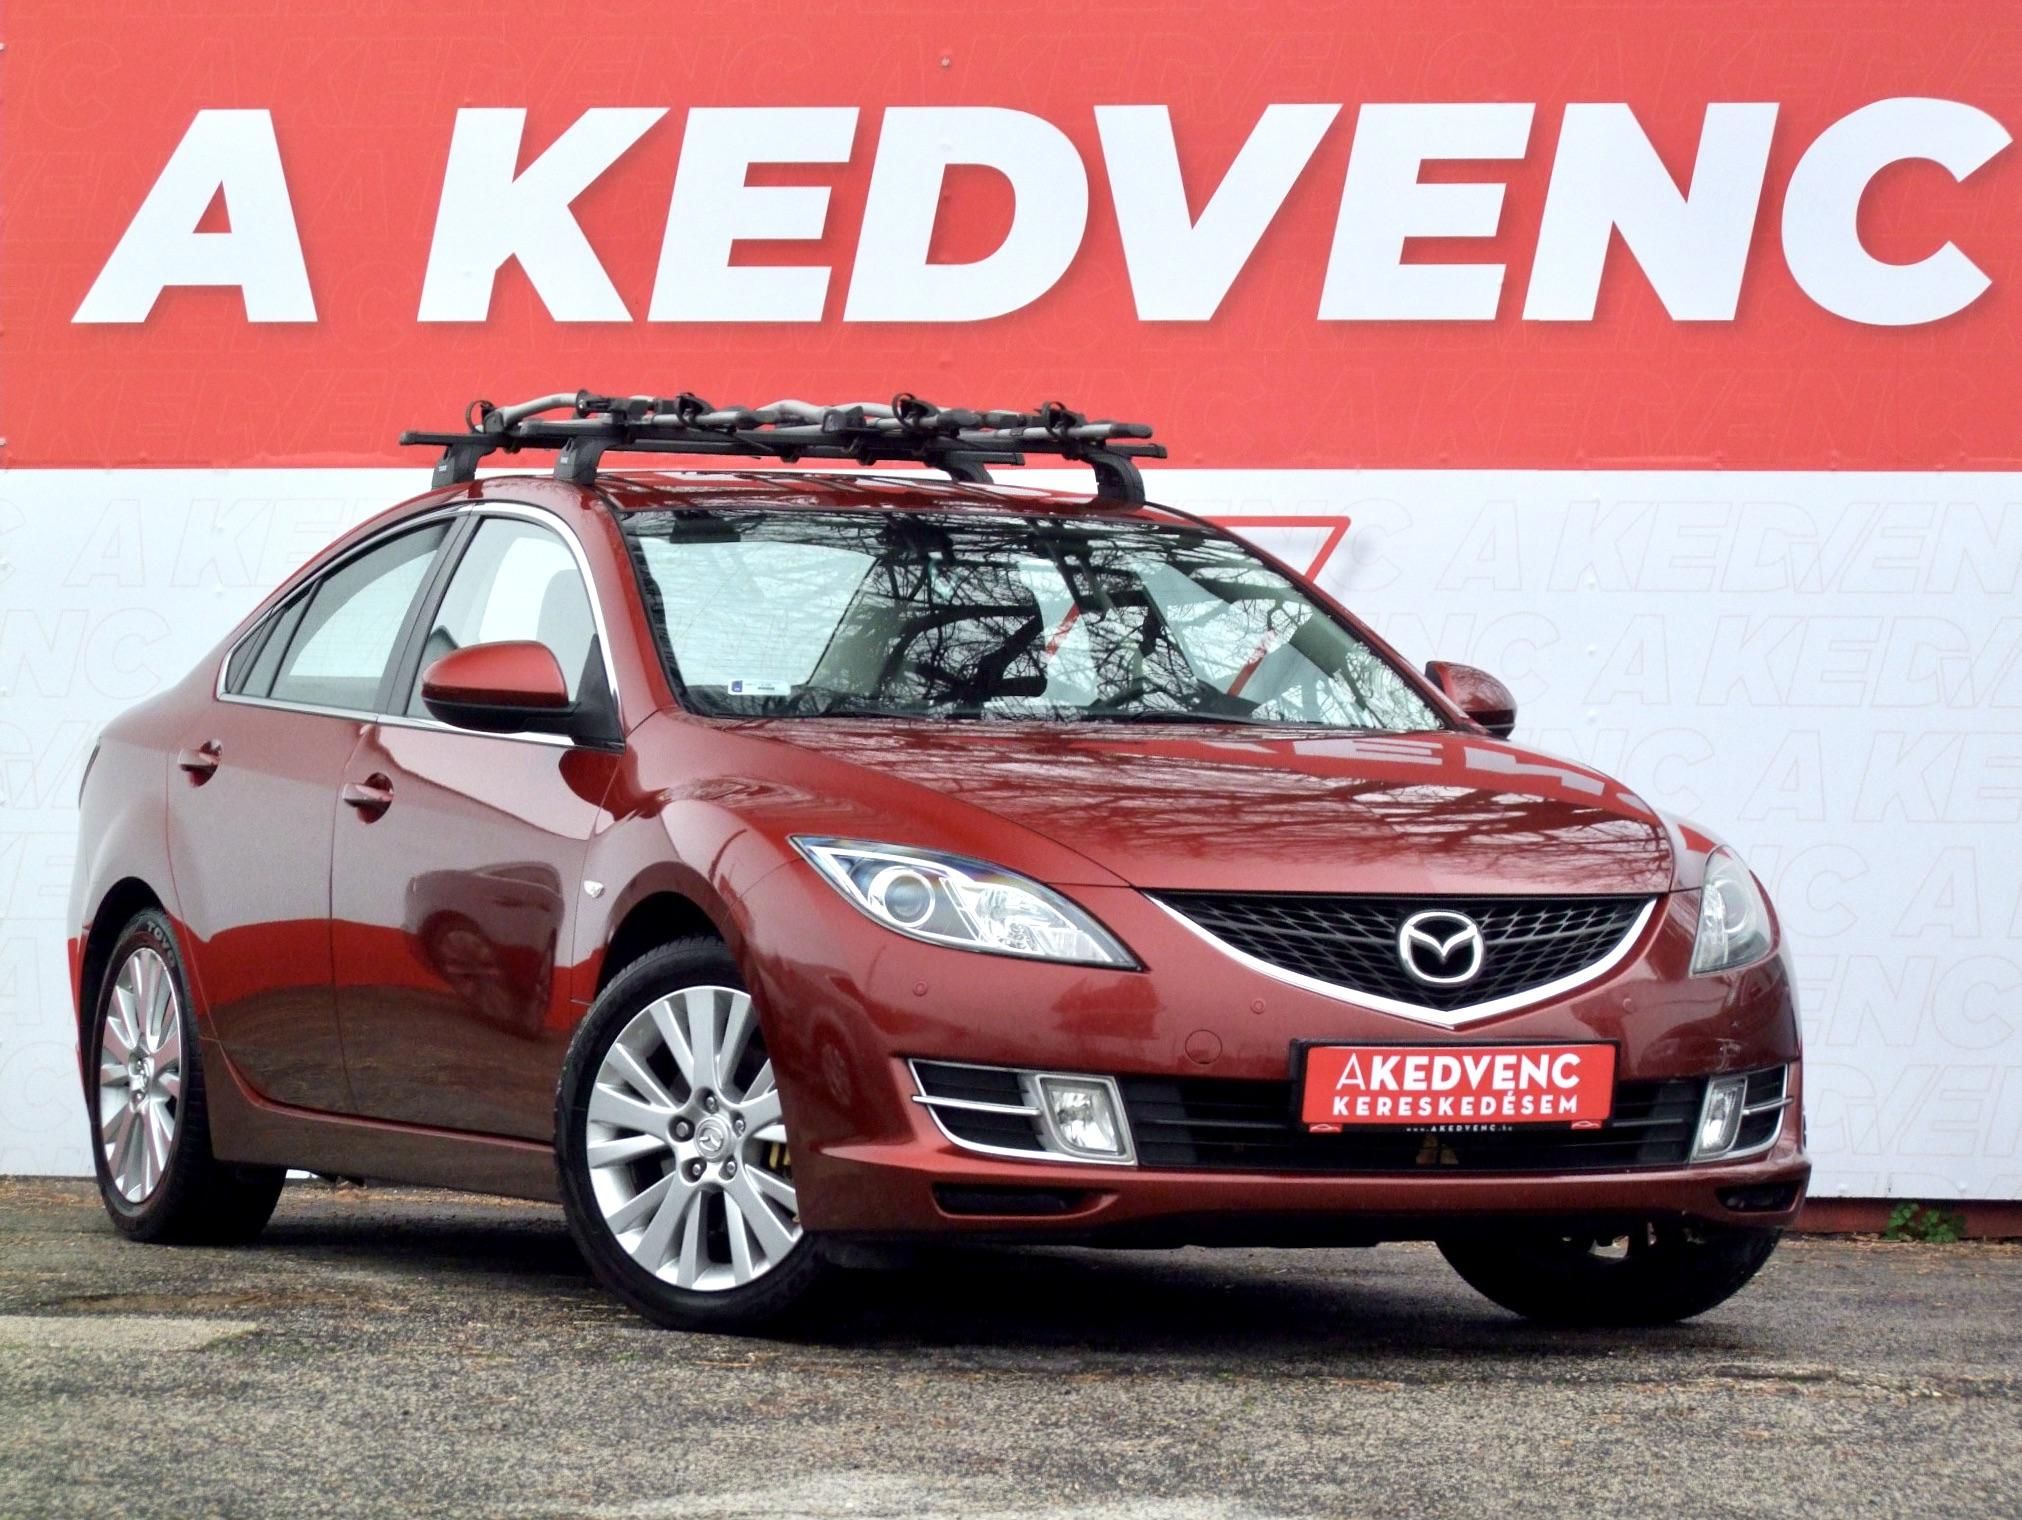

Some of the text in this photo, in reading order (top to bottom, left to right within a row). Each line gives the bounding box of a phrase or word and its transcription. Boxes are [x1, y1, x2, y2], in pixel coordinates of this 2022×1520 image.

[72, 108, 318, 324] A
[417, 97, 2012, 326] KEDVENC
[1332, 1091, 1578, 1117] KERESKEDÉSEM
